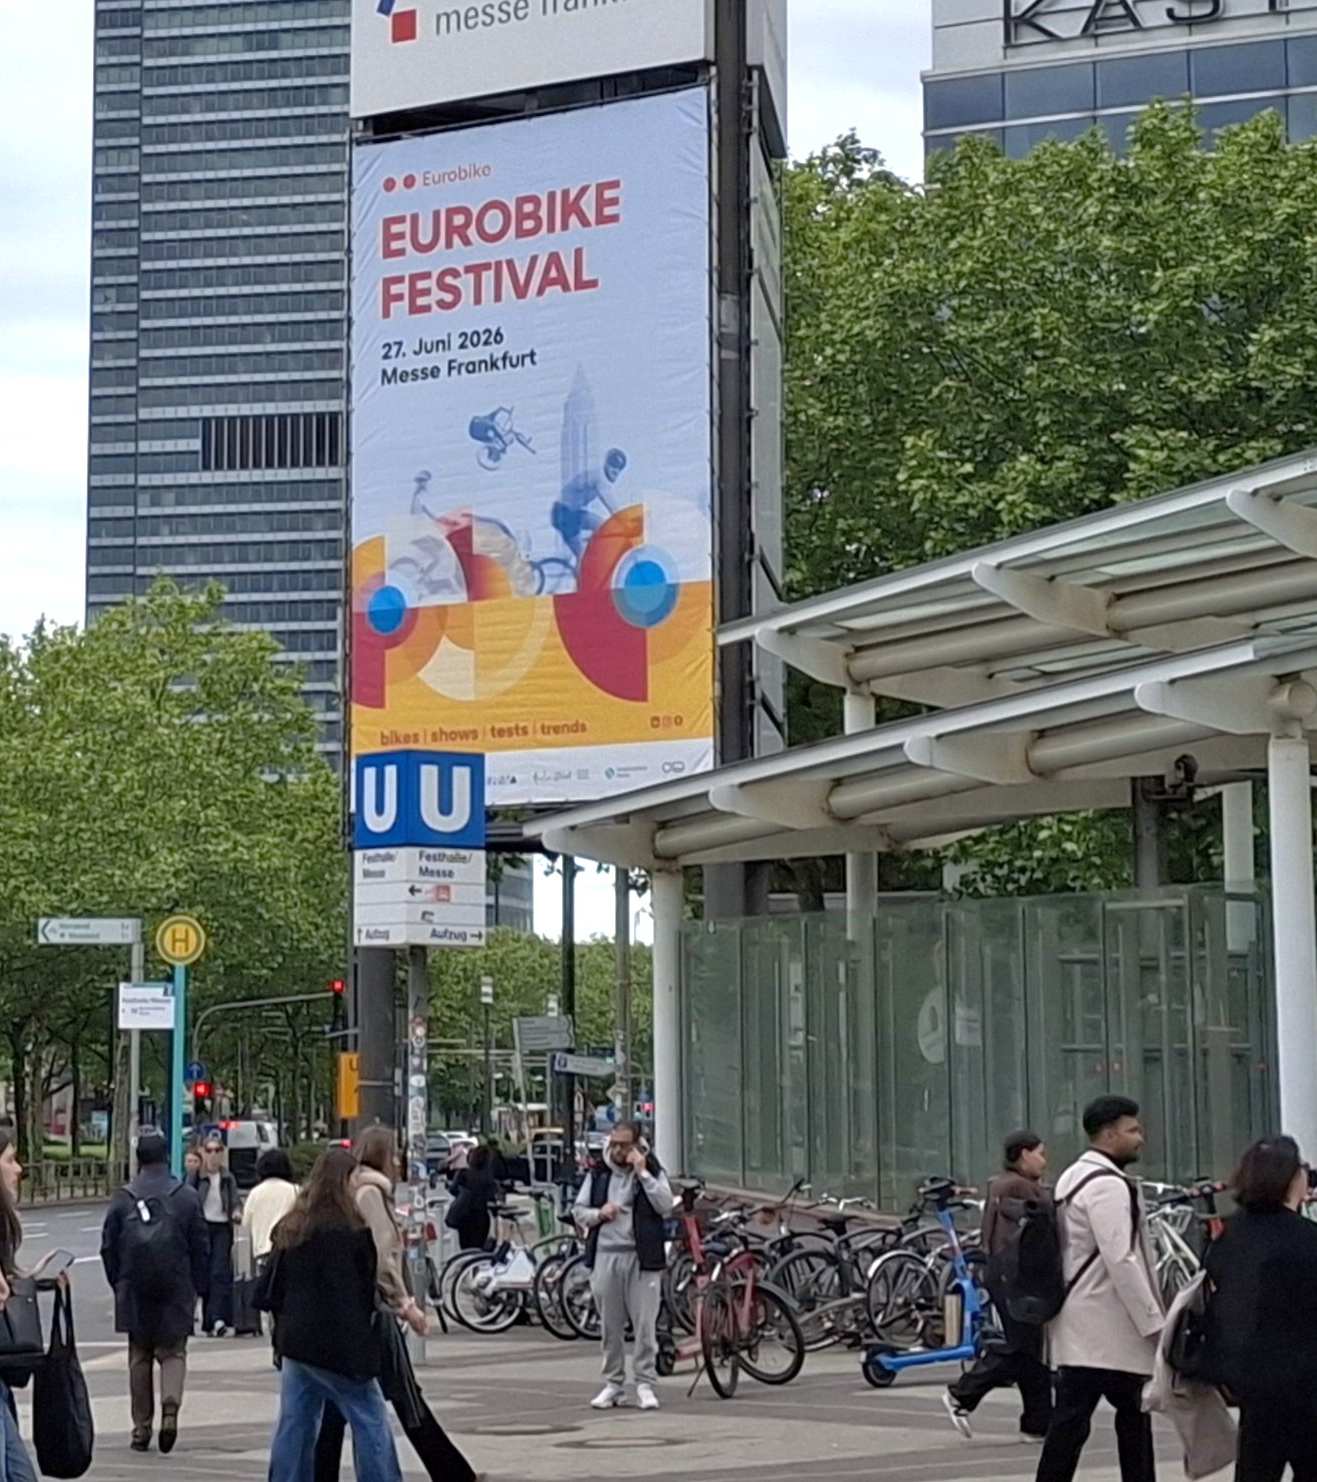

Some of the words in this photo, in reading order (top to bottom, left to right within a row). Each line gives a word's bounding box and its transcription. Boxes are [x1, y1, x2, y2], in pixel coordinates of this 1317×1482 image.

[435, 0, 529, 36] messe
[423, 163, 491, 187] Eurobike
[382, 180, 621, 260] EUROBIKE
[382, 247, 599, 320] FESTIVAL
[382, 341, 407, 360] 27.
[413, 333, 452, 356] Juni
[458, 327, 504, 349] 2026
[381, 365, 441, 386] Messe
[447, 349, 537, 377] Frankfurt
[380, 731, 420, 746] bikes
[431, 728, 478, 742] shows
[490, 724, 529, 738] tests
[540, 720, 587, 735] trends
[363, 764, 398, 834] U
[420, 764, 471, 833] U
[418, 866, 455, 879] Messe
[171, 928, 189, 953] H
[429, 927, 468, 942] Aufzug
